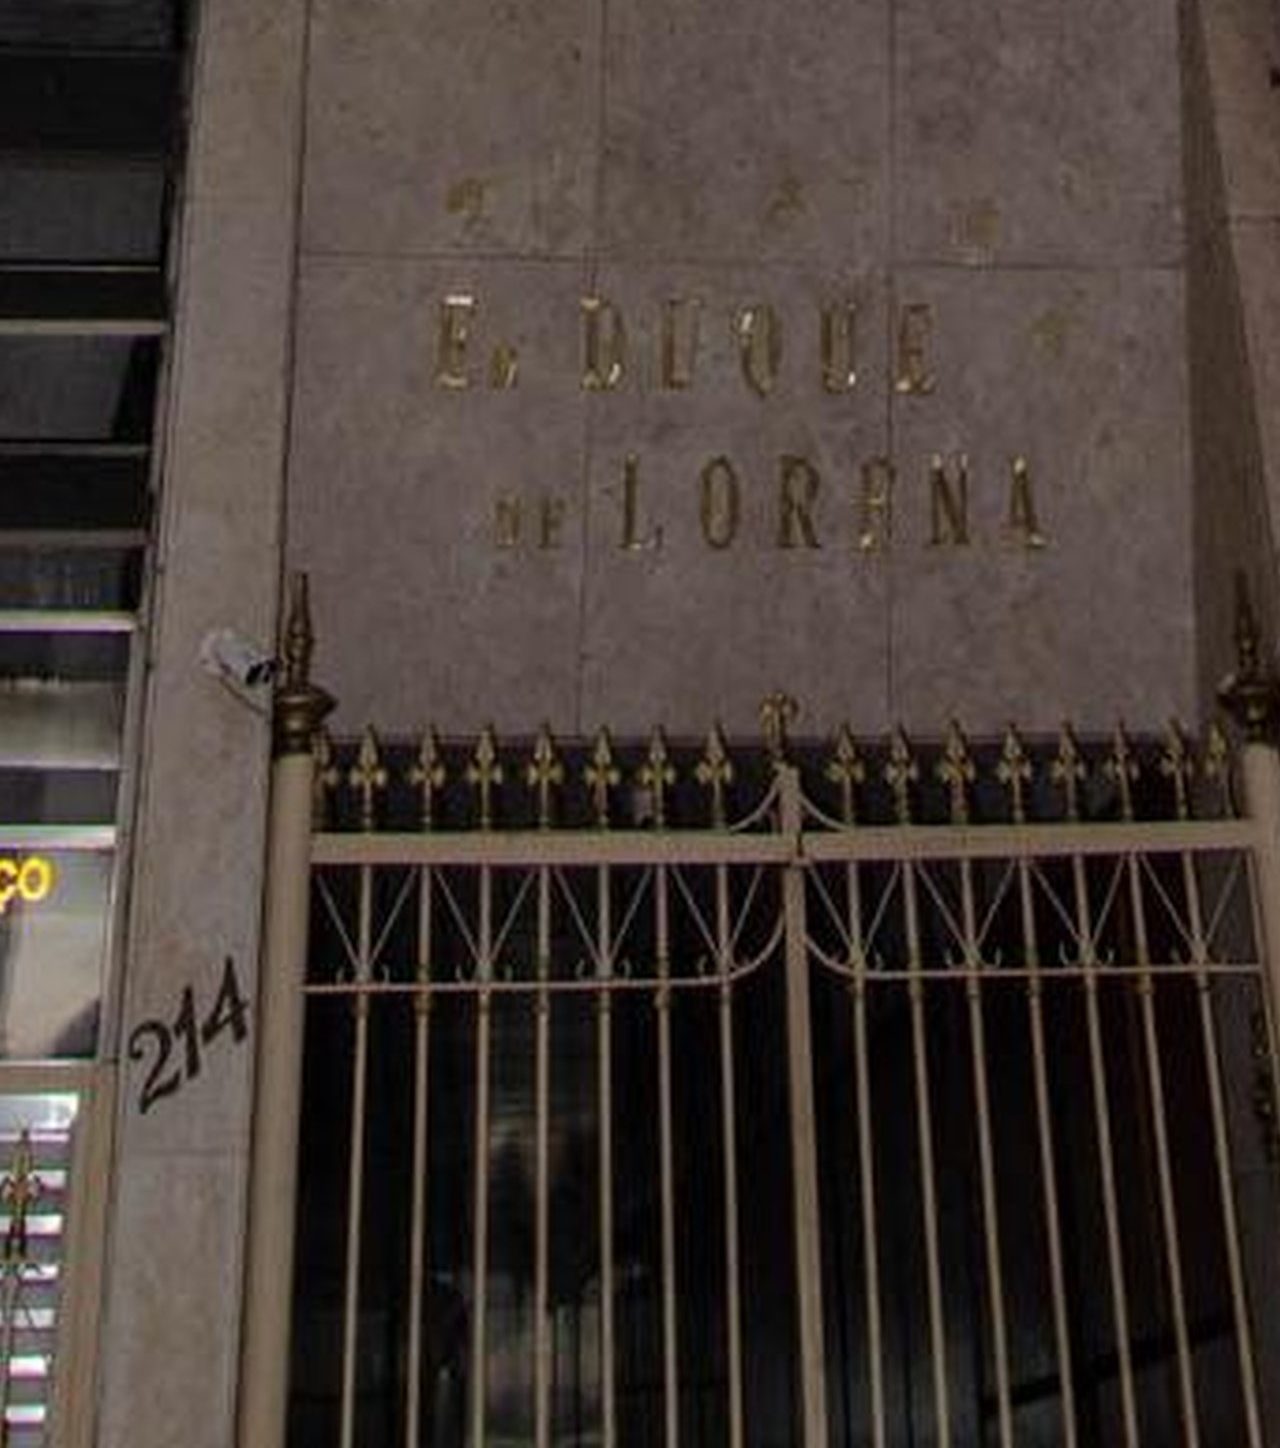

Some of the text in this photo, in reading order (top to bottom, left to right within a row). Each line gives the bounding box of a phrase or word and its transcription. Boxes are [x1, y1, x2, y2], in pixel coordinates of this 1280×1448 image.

[579, 296, 937, 396] DUQUE
[619, 453, 1051, 552] LORENA
[129, 955, 250, 1115] 214
